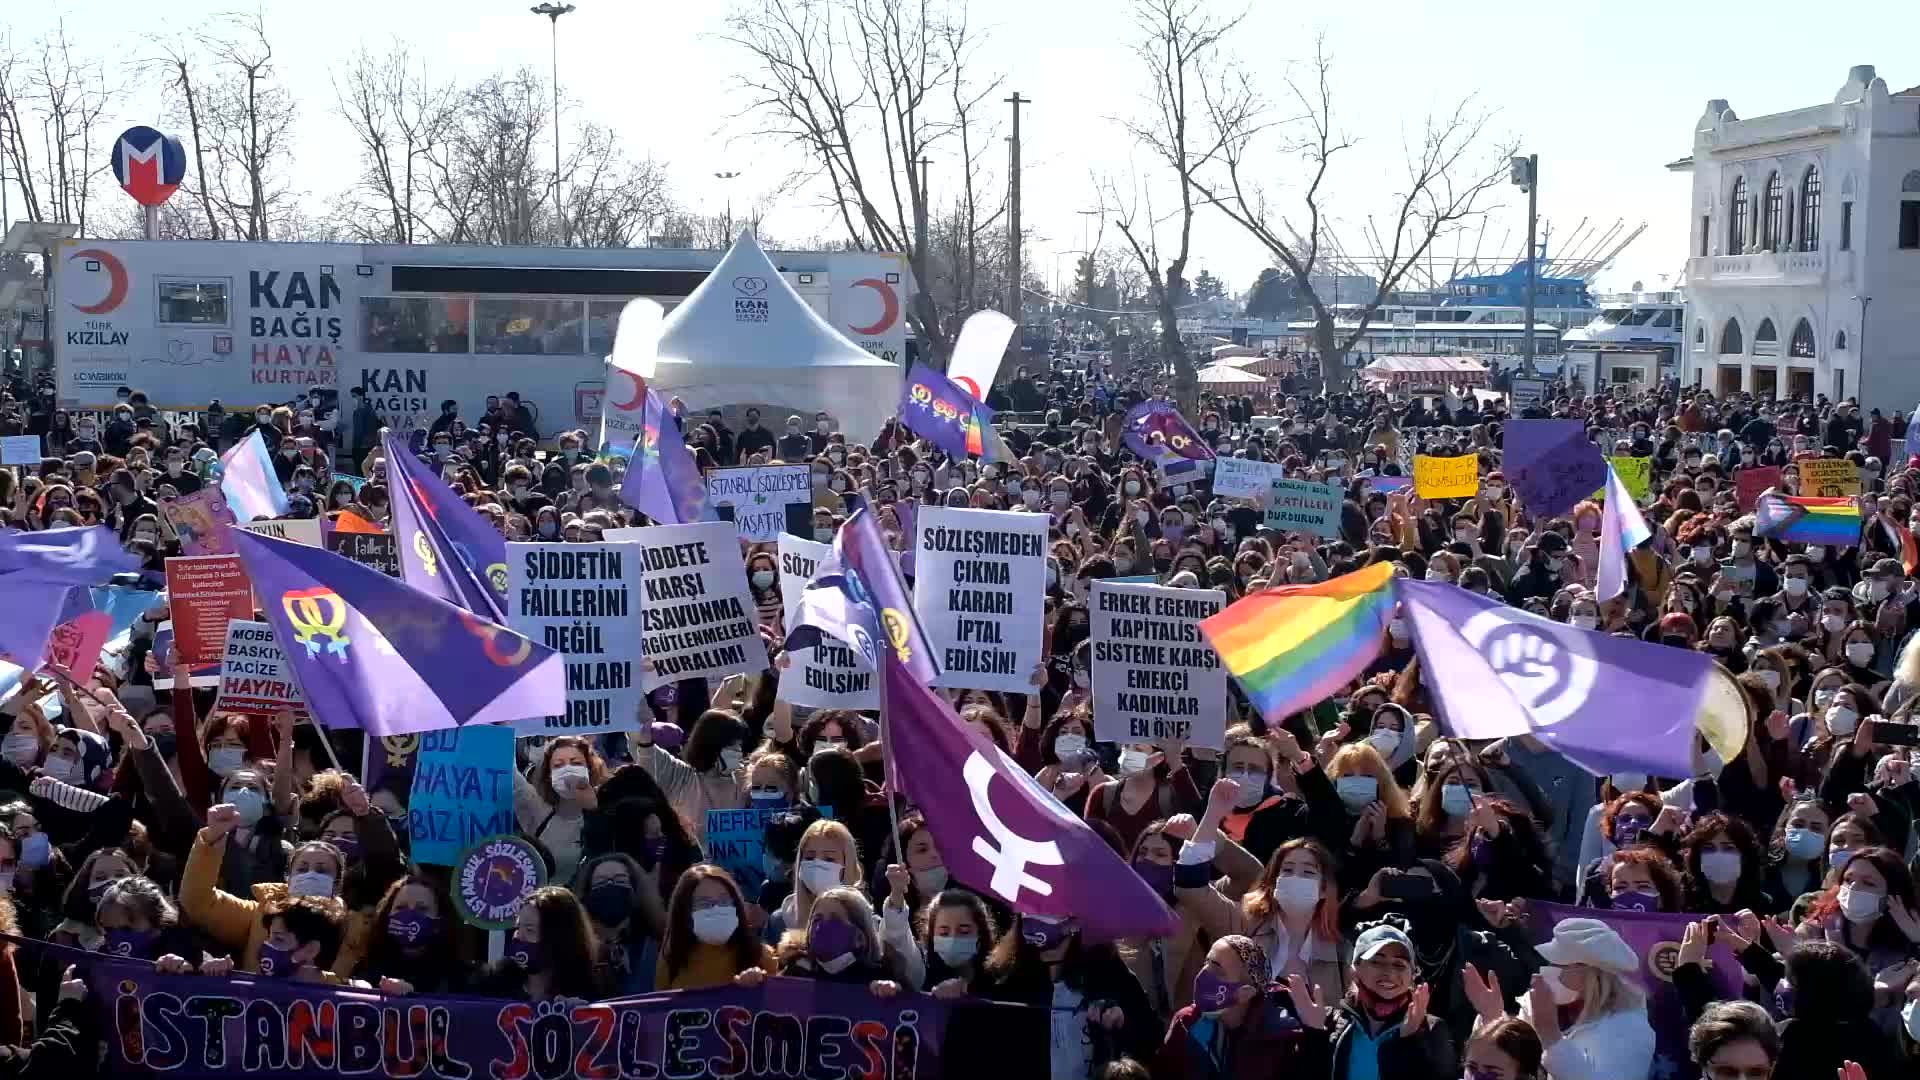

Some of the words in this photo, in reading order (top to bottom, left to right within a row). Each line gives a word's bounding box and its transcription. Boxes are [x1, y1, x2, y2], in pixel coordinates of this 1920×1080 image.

[121, 136, 164, 185] M
[736, 300, 768, 308] KAN
[67, 331, 129, 345] KIZILAY
[362, 368, 427, 393] KAN
[735, 511, 785, 534] YAŞATIR
[924, 527, 1043, 558] SÖZLEŞMEDEN
[525, 548, 622, 585] ŞİDDETİN
[953, 560, 1010, 588] ÇIKMA
[521, 584, 628, 617] FAİLLERİNİ
[645, 573, 706, 601] KARŞI
[641, 597, 745, 632] ZSAVUNMA
[949, 589, 1013, 615] KARARI
[1099, 591, 1151, 613] ERKEK
[1155, 596, 1220, 618] EGEMEN
[232, 629, 275, 641] MOBB
[544, 621, 605, 654] DEĞİL
[641, 618, 755, 655] RGÜTLENMELERİ
[957, 617, 1003, 645] İPTAL
[226, 660, 278, 676] TACİZE
[652, 645, 747, 677] KURALIM!
[945, 646, 1017, 675] EDİLSİN!
[1095, 639, 1166, 666] SİSTEME
[1169, 647, 1220, 670] KARŞI
[805, 665, 870, 694] EDİLSİN!
[1127, 669, 1188, 694] EMEKÇİ
[1117, 692, 1199, 716] KADINLAR
[1129, 718, 1150, 738] EN
[414, 761, 510, 800] HAYAT
[708, 835, 753, 859] İNAT
[115, 980, 472, 1079] İSTANBUL
